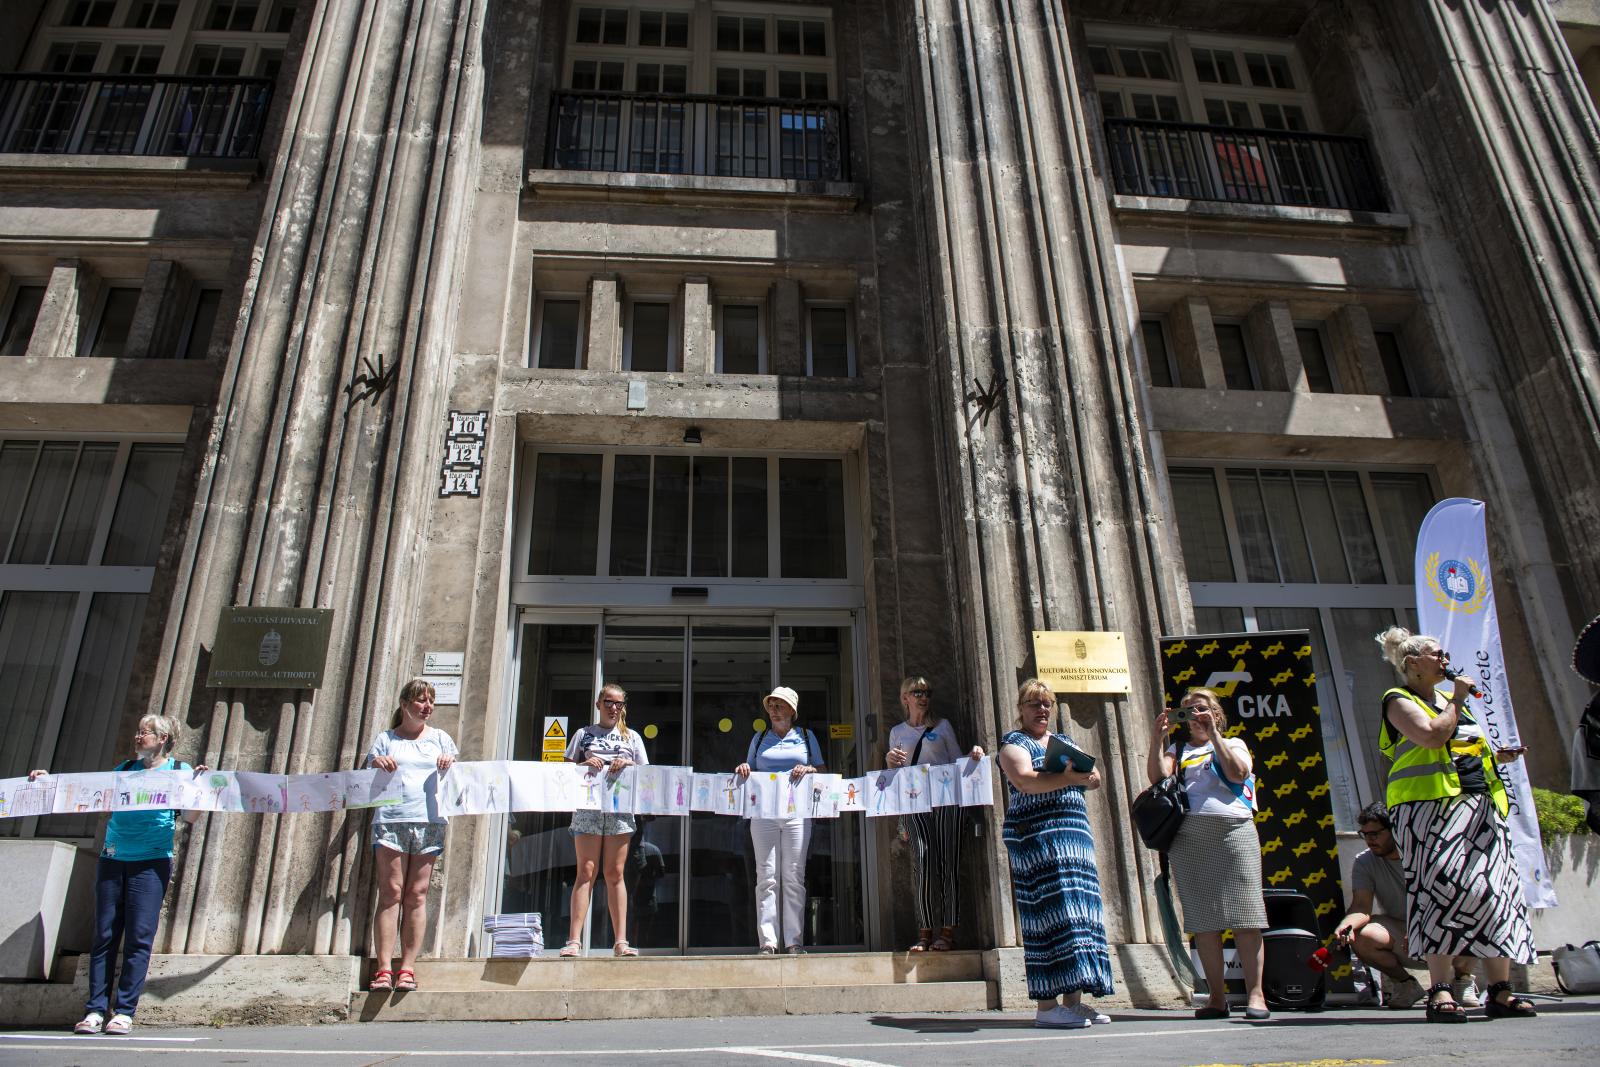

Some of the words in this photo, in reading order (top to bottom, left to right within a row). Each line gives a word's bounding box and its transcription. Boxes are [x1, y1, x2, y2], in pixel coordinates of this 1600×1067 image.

[460, 420, 475, 433] 10
[456, 448, 472, 461] 12
[453, 478, 468, 491] 14
[280, 616, 318, 625] HIVATAL
[214, 670, 268, 678] EDUCATIONAL
[272, 671, 318, 679] AUTHORITY
[1060, 673, 1108, 681] MINISZTÉRIUM
[1237, 694, 1293, 718] CKA
[1475, 650, 1521, 816] Szakzervezete
